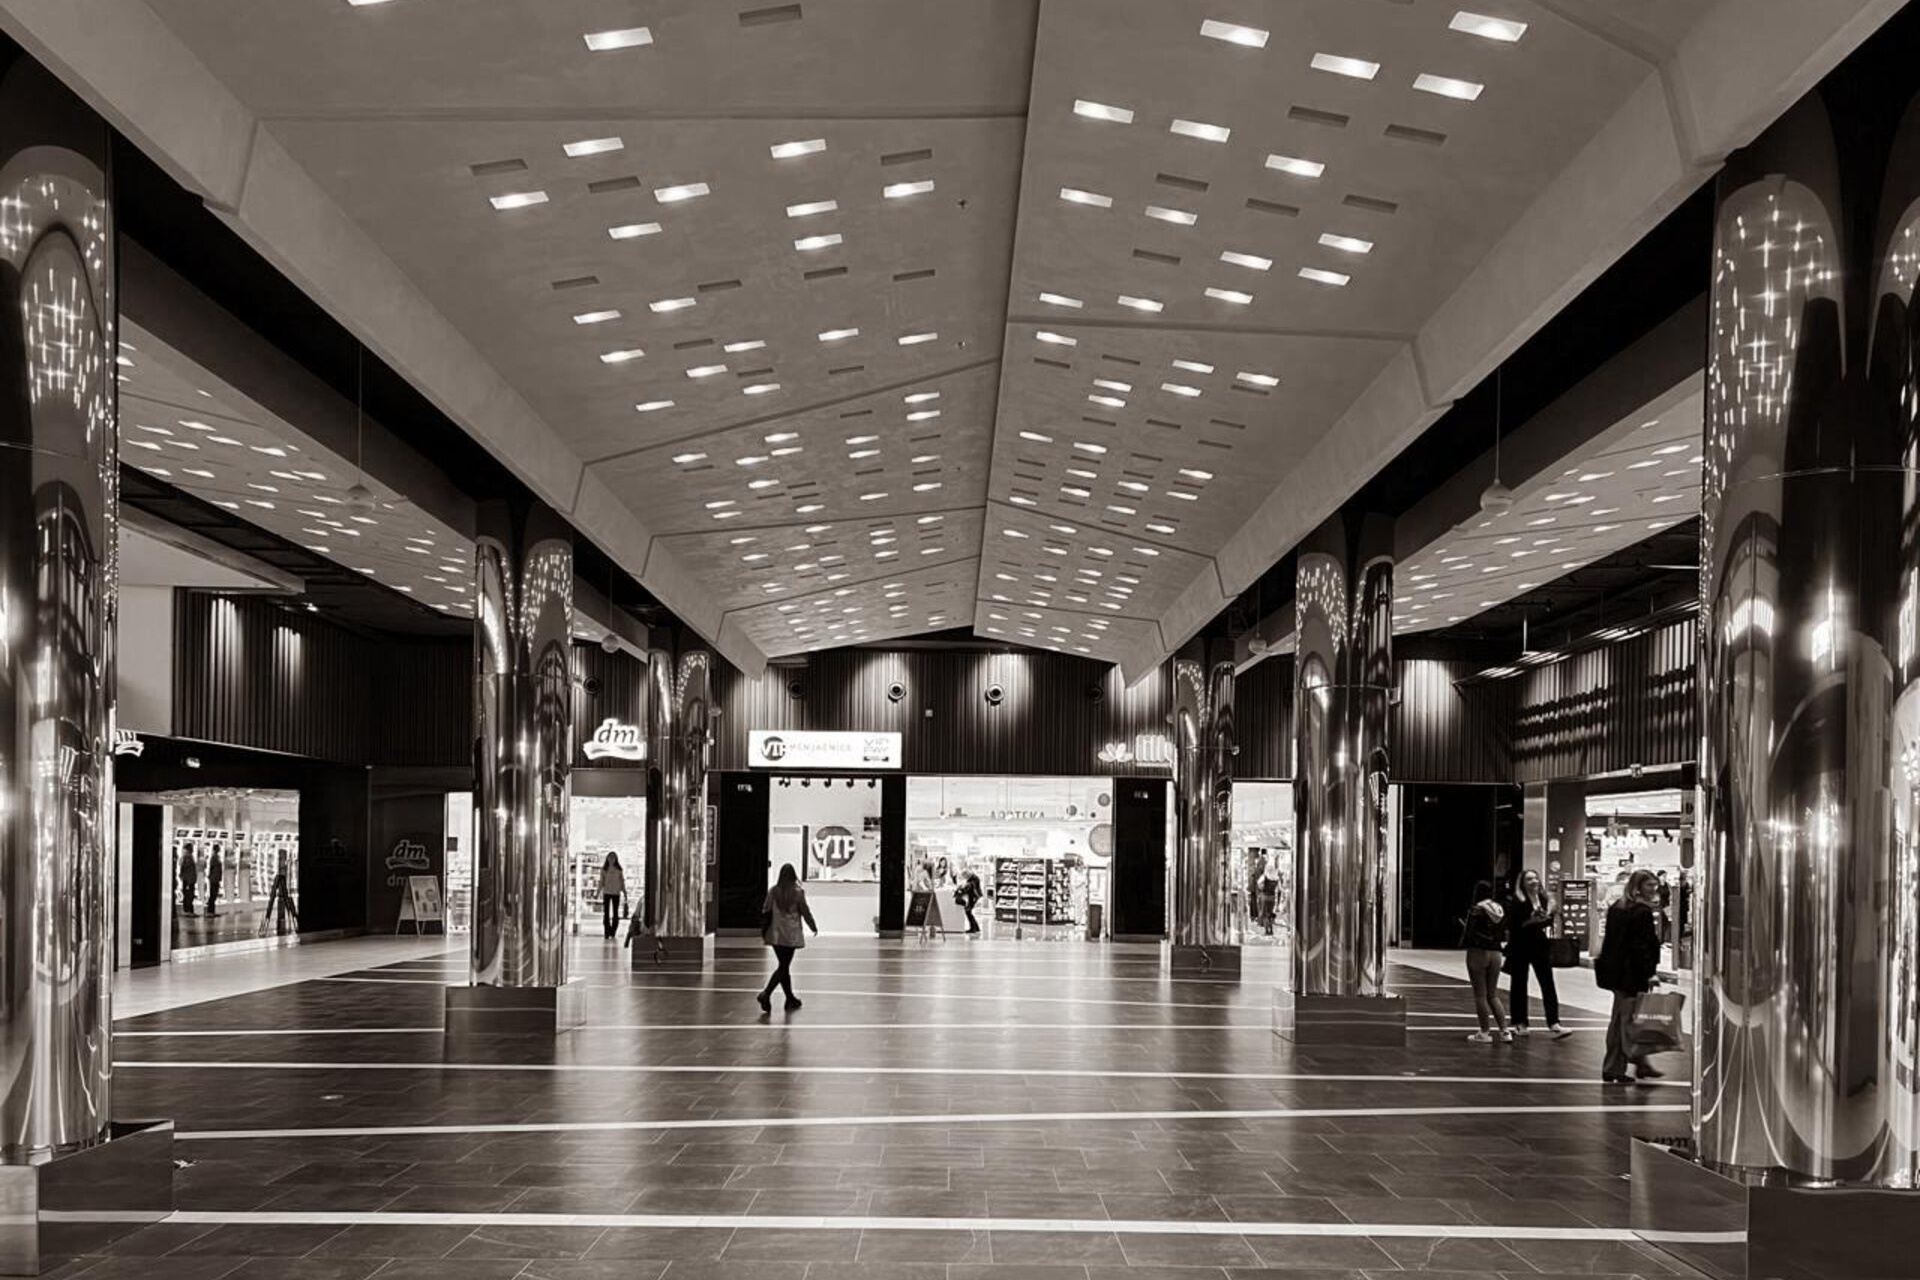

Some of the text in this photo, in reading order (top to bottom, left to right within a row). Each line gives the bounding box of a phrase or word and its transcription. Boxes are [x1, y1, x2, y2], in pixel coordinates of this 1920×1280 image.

[598, 722, 635, 743] dm
[394, 840, 425, 859] dm
[811, 834, 856, 860] VIP
